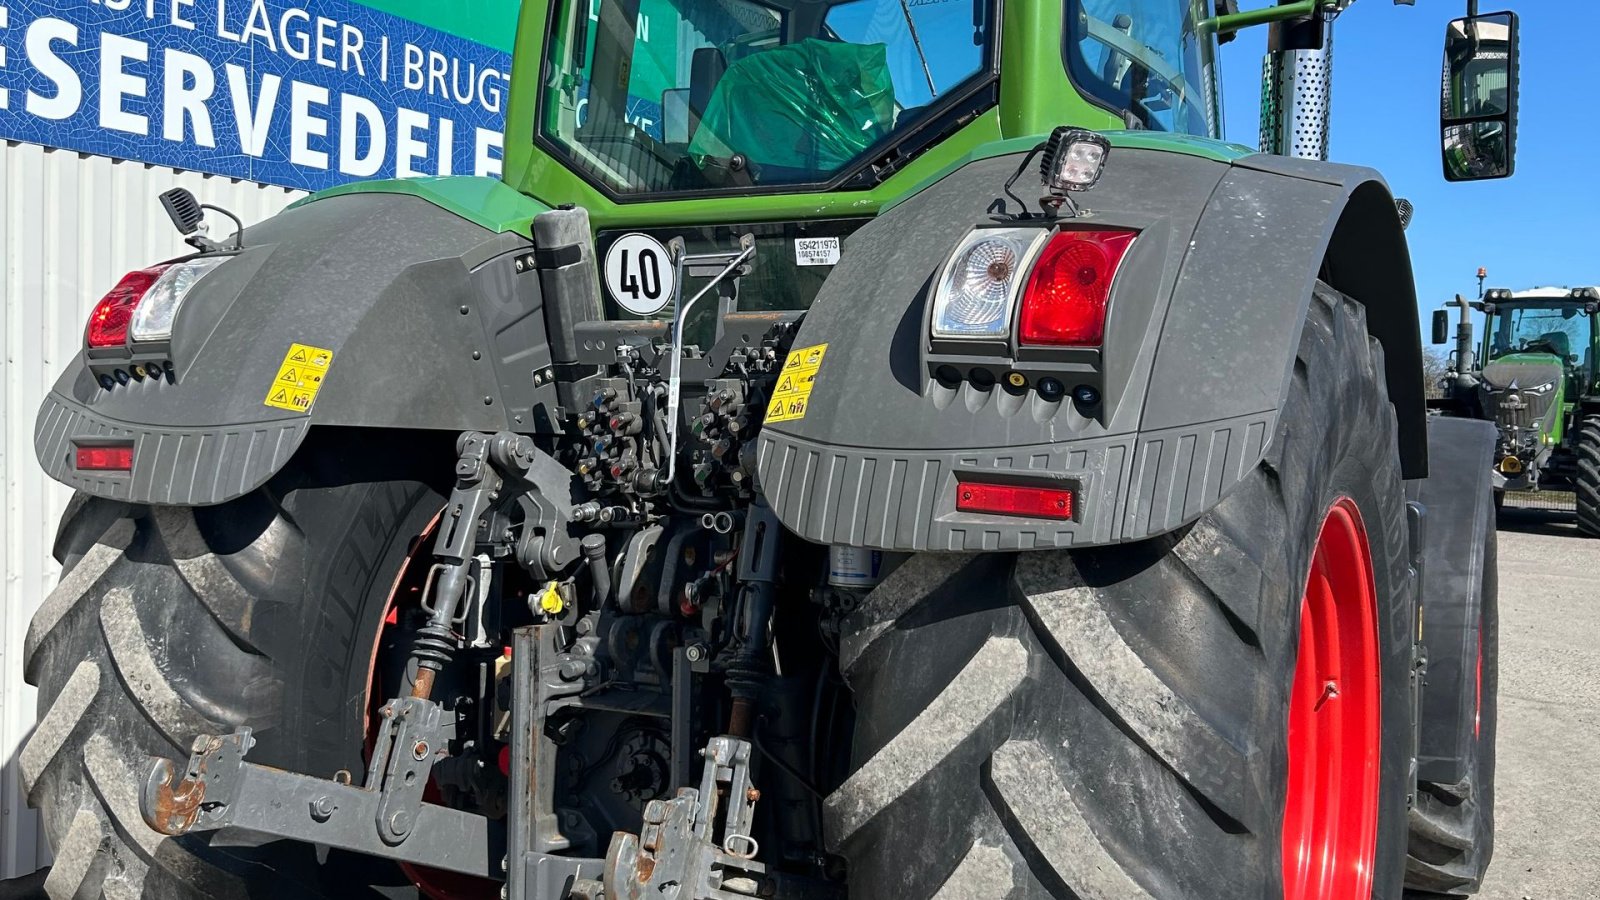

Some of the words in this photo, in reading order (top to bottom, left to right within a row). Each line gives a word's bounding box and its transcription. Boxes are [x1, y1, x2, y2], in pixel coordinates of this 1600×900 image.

[218, 0, 365, 76] LAGER
[381, 35, 388, 82] I
[404, 42, 511, 113] BRUG
[621, 249, 662, 300] 40
